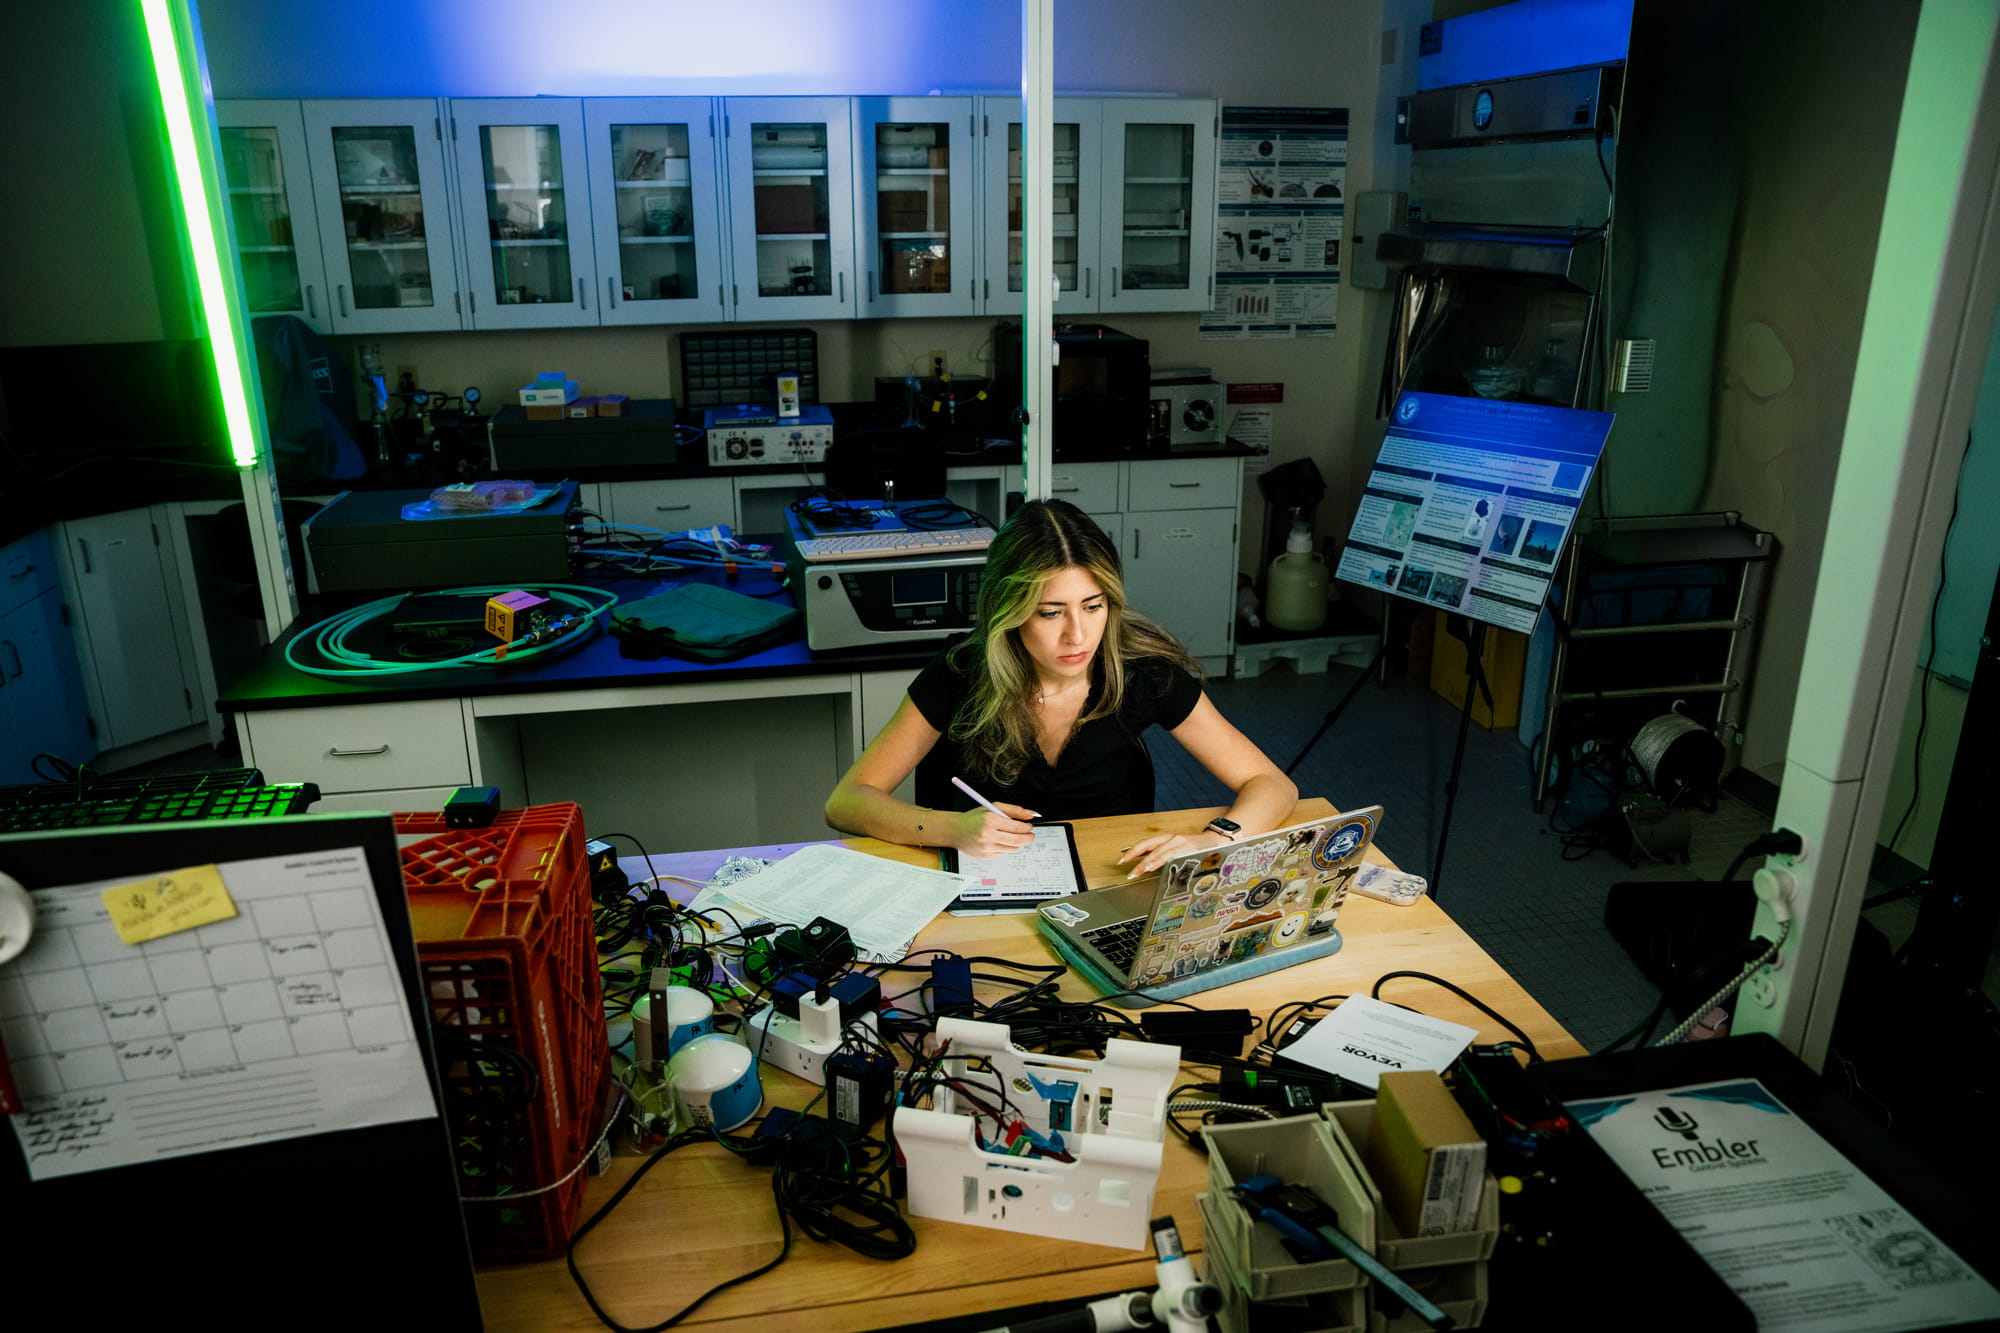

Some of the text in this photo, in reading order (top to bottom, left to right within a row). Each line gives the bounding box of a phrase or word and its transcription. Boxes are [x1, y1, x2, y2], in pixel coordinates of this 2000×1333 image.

[1342, 1045, 1402, 1069] VEVOR
[1652, 1138, 1760, 1168] Embler
[1689, 1156, 1768, 1173] Control Systems
